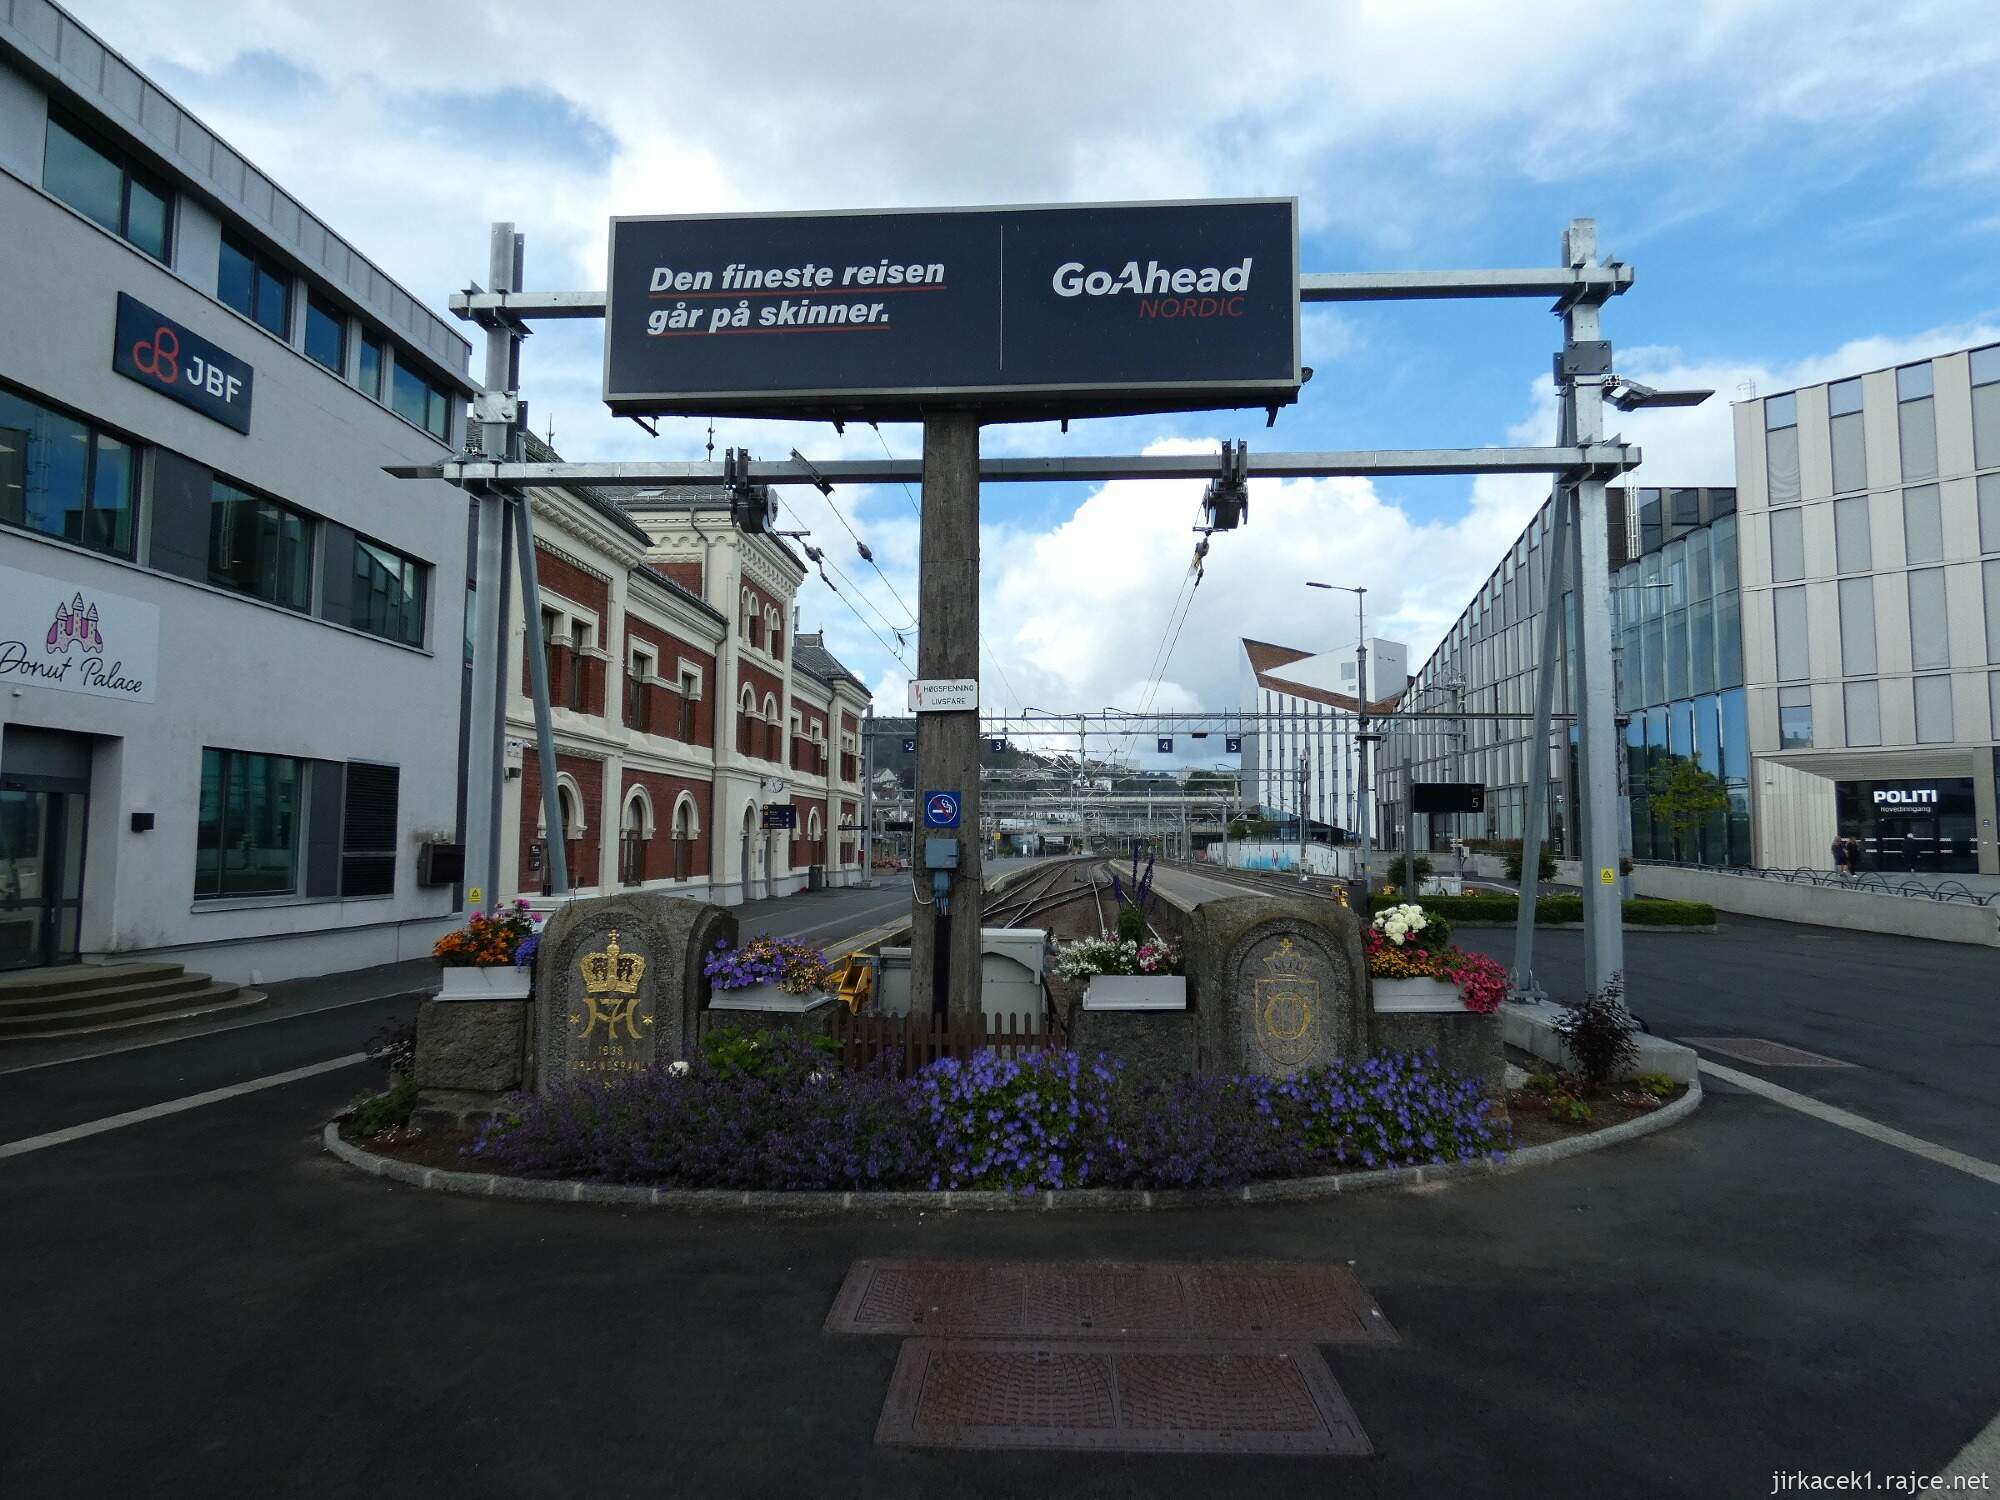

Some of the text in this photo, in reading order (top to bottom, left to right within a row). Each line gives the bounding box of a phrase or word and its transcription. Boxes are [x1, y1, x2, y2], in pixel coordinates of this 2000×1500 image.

[650, 259, 945, 292] Den fineste reisen
[1052, 258, 1253, 297] GoAhead
[647, 299, 889, 335] går på skinner.
[1139, 297, 1245, 319] NORDIC
[186, 356, 243, 403] JBF
[0, 641, 143, 693] Donut Palace
[995, 742, 1001, 750] 3
[1162, 742, 1169, 751] 4
[1231, 742, 1237, 751] 5
[1472, 797, 1479, 807] 5
[1873, 790, 1937, 803] POLITI
